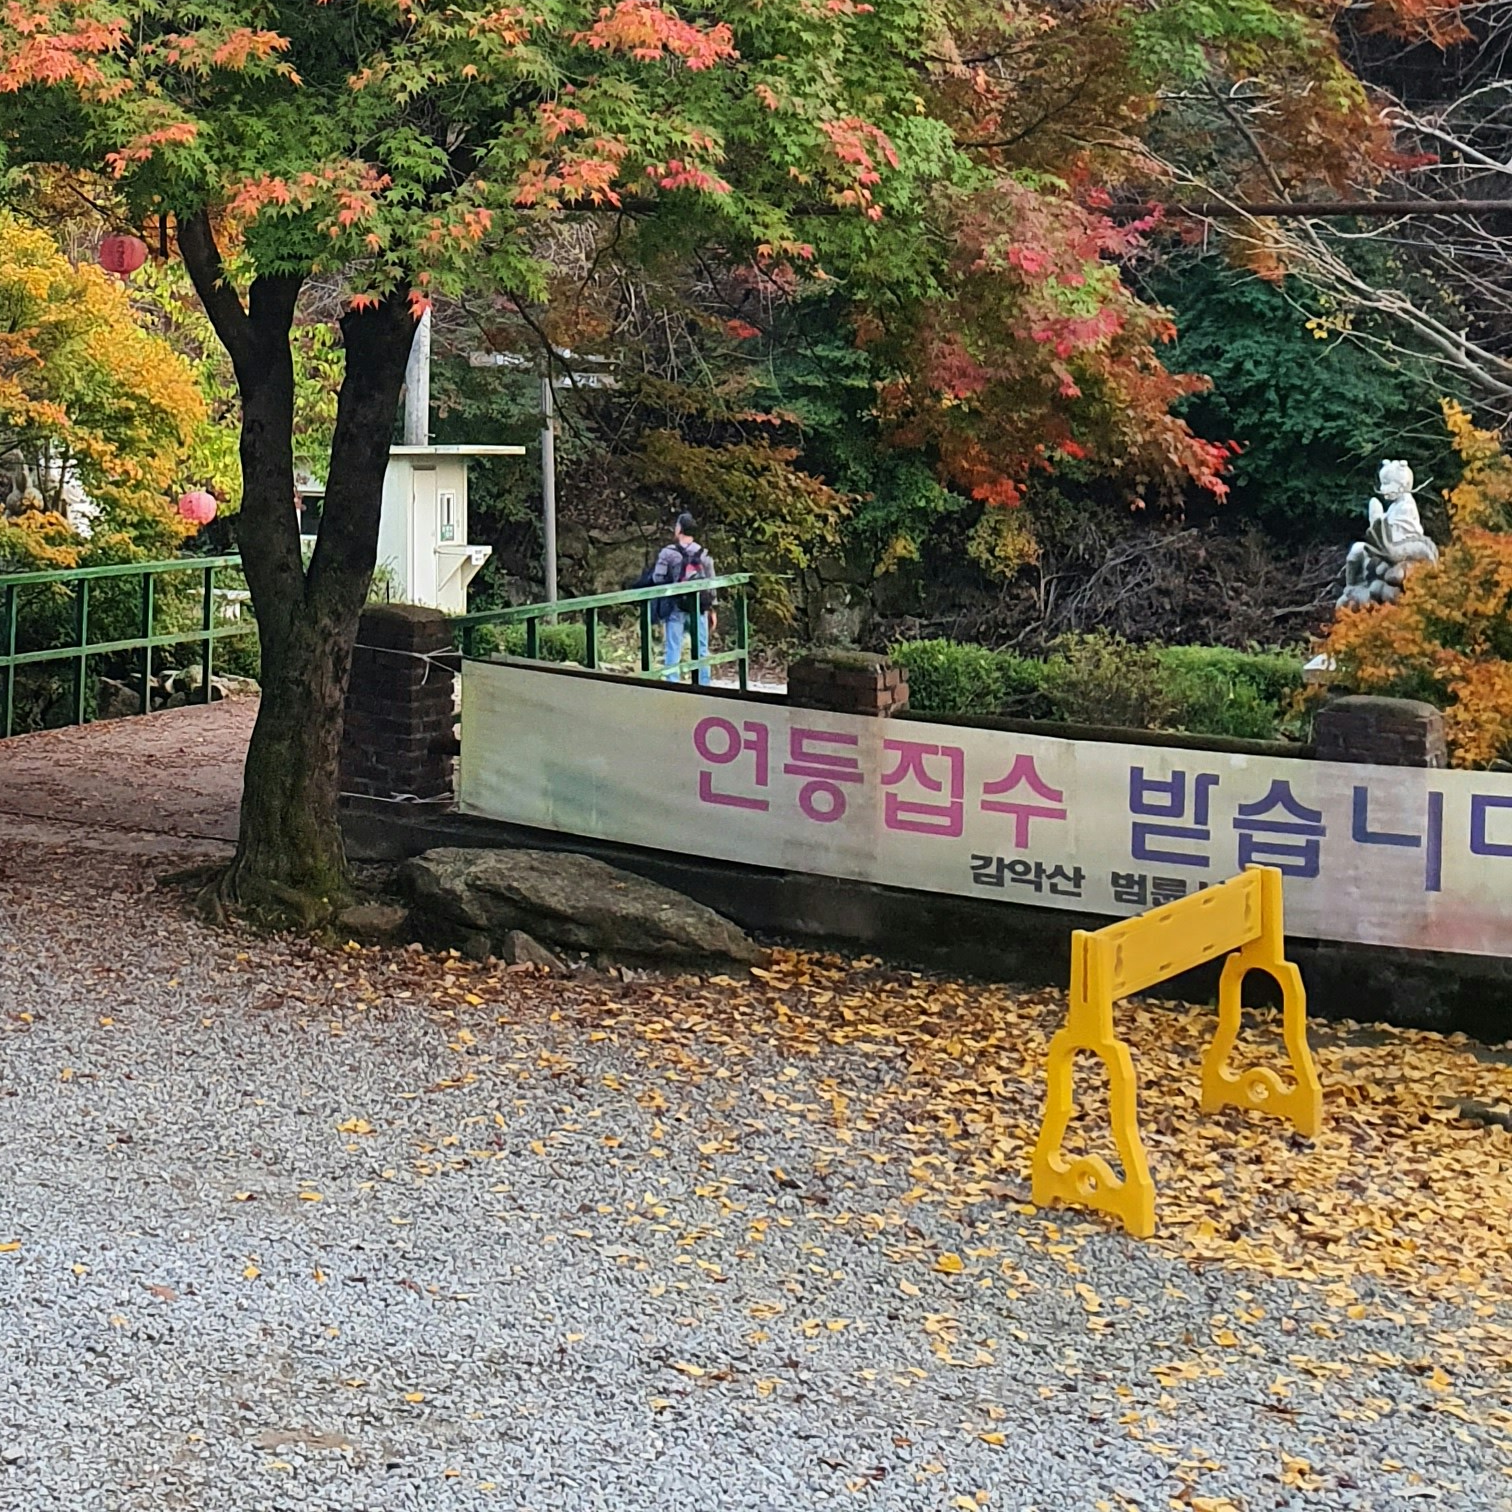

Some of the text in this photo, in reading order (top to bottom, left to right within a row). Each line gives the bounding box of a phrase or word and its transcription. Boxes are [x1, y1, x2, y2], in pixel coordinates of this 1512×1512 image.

[693, 716, 1512, 891] 연등접수 받습니
[969, 853, 1226, 908] 감악산 범륜
